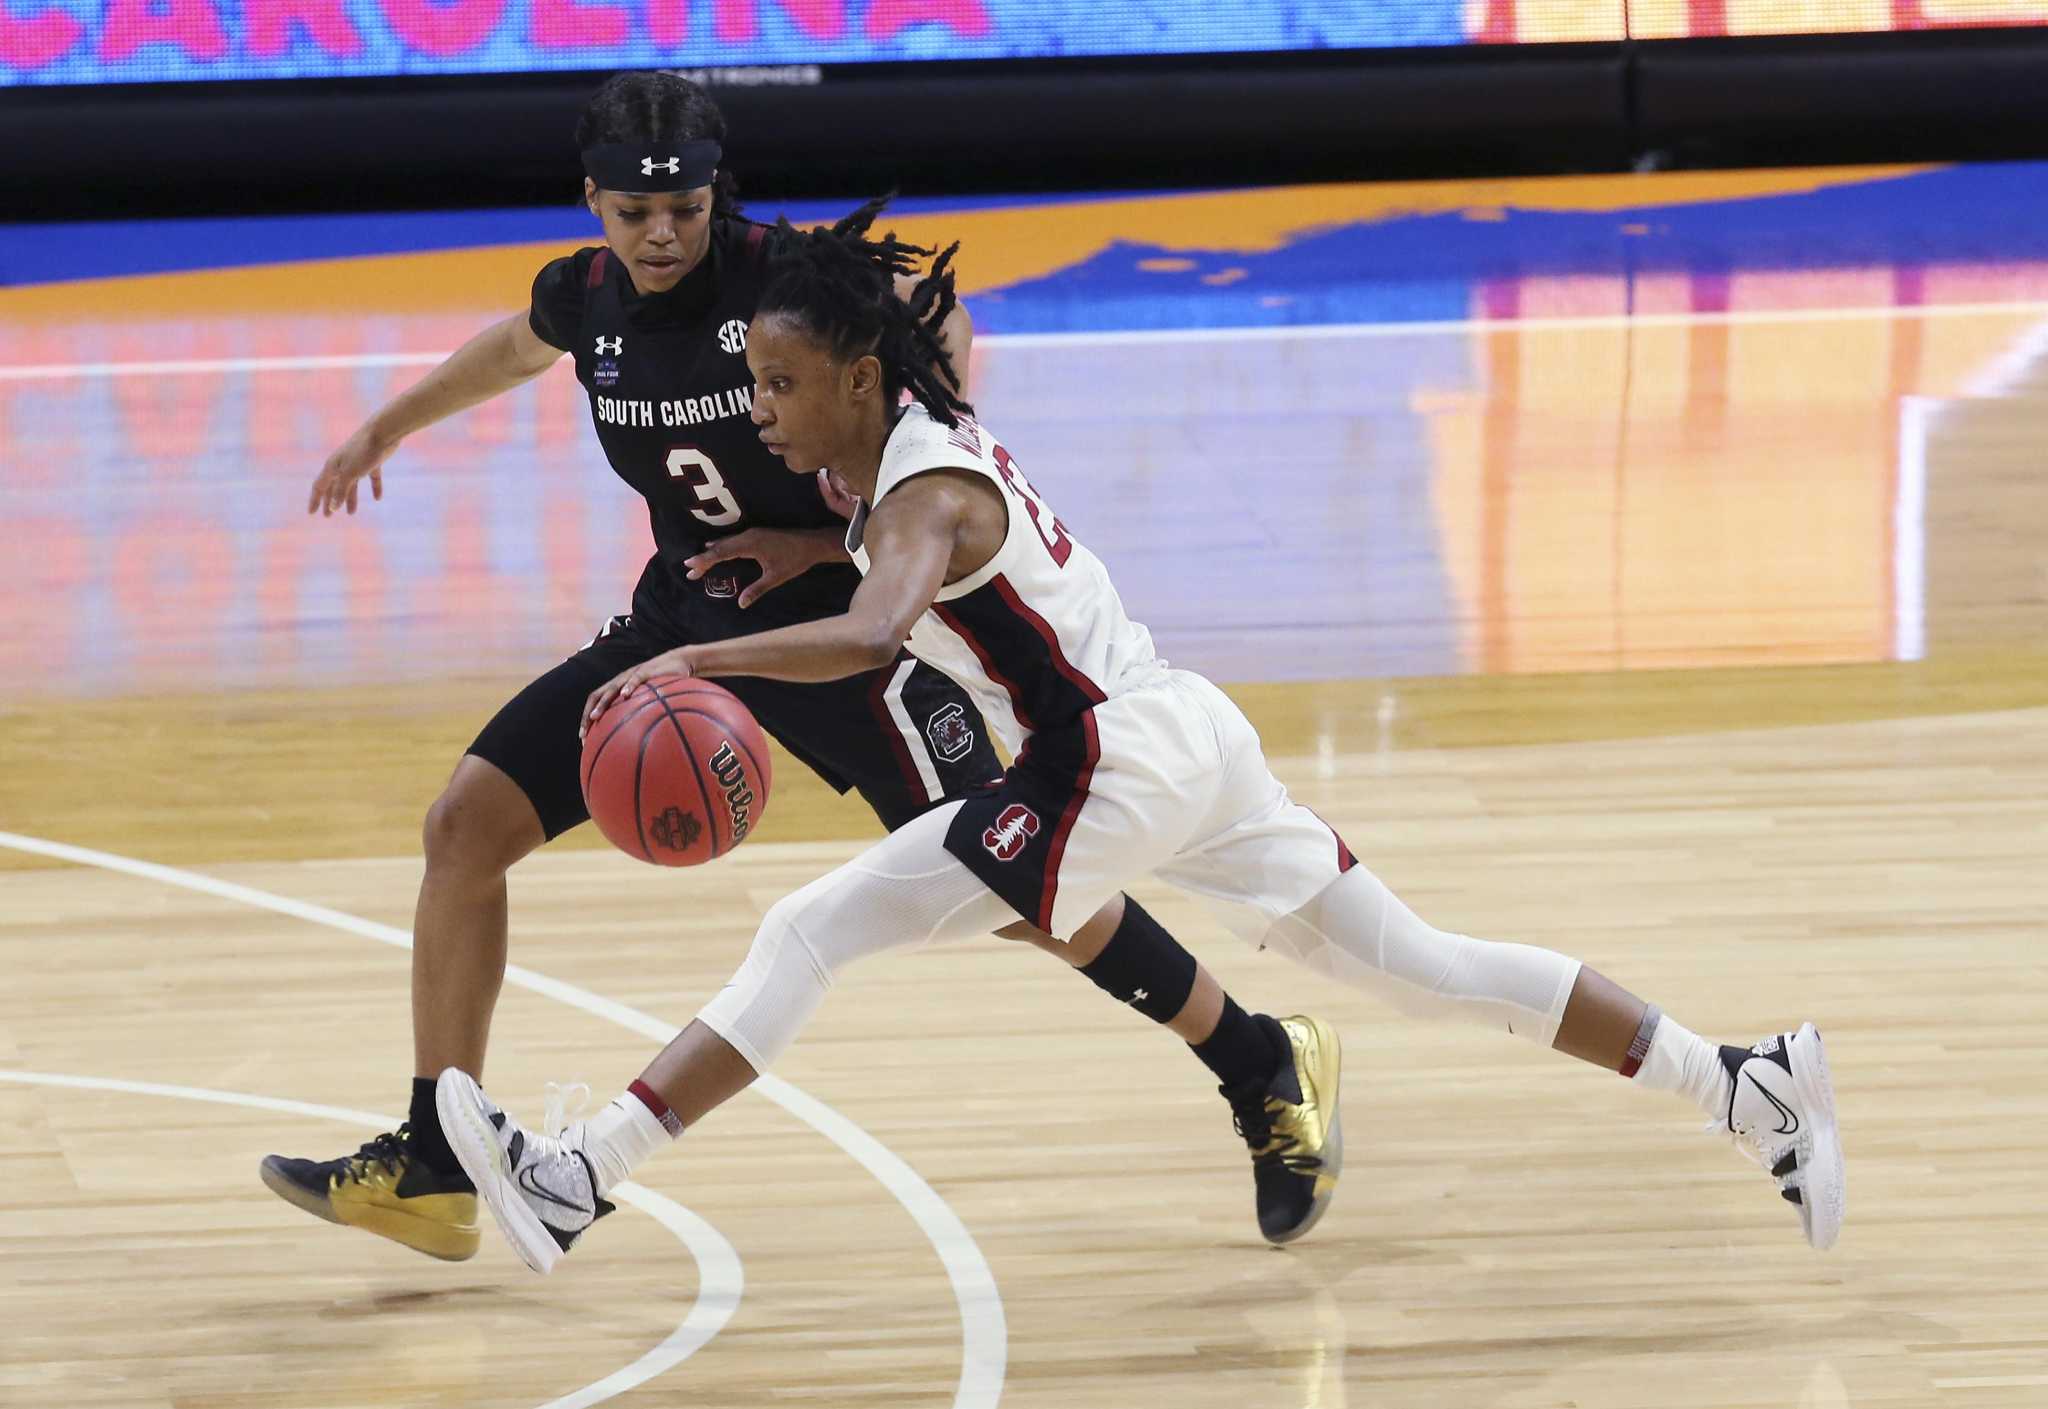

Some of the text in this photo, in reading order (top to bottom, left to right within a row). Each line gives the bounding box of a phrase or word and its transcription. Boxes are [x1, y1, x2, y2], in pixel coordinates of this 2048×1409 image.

[597, 384, 757, 427] SOUTH CAROLIN
[665, 448, 742, 526] 3
